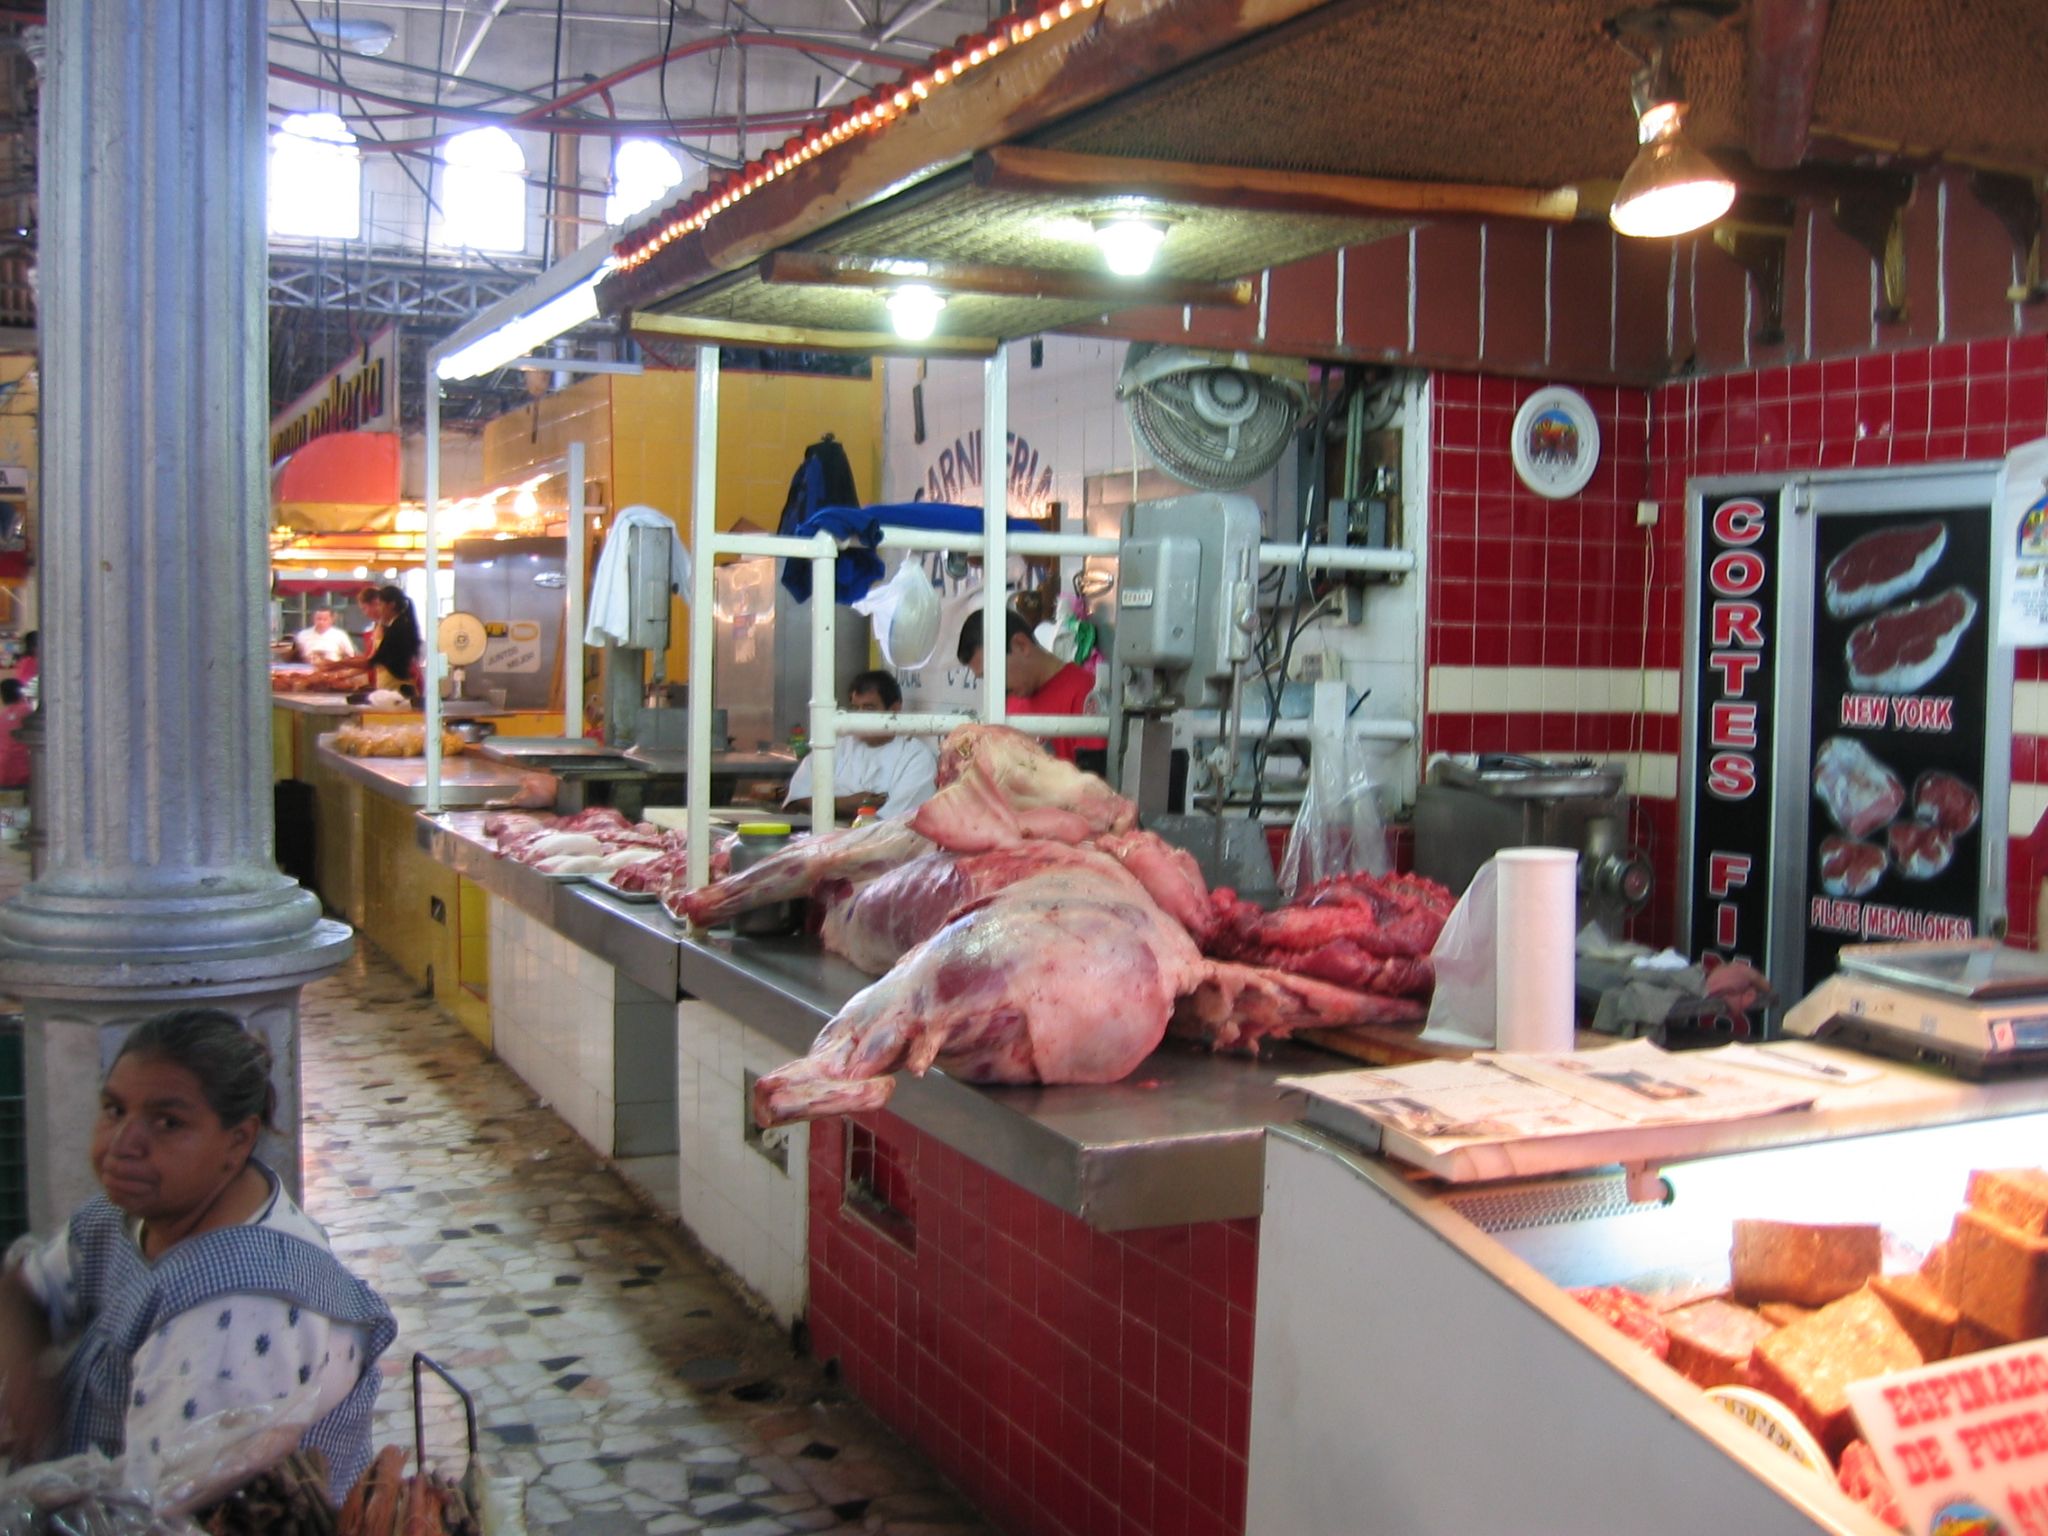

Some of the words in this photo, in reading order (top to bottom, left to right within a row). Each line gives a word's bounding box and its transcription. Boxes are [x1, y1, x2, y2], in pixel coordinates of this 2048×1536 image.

[1709, 500, 1765, 799] CORTES
[1841, 694, 1889, 727] NEW
[1891, 696, 1953, 731] YORK
[1811, 897, 1861, 932] FILETE
[1894, 1436, 1953, 1487] DE
